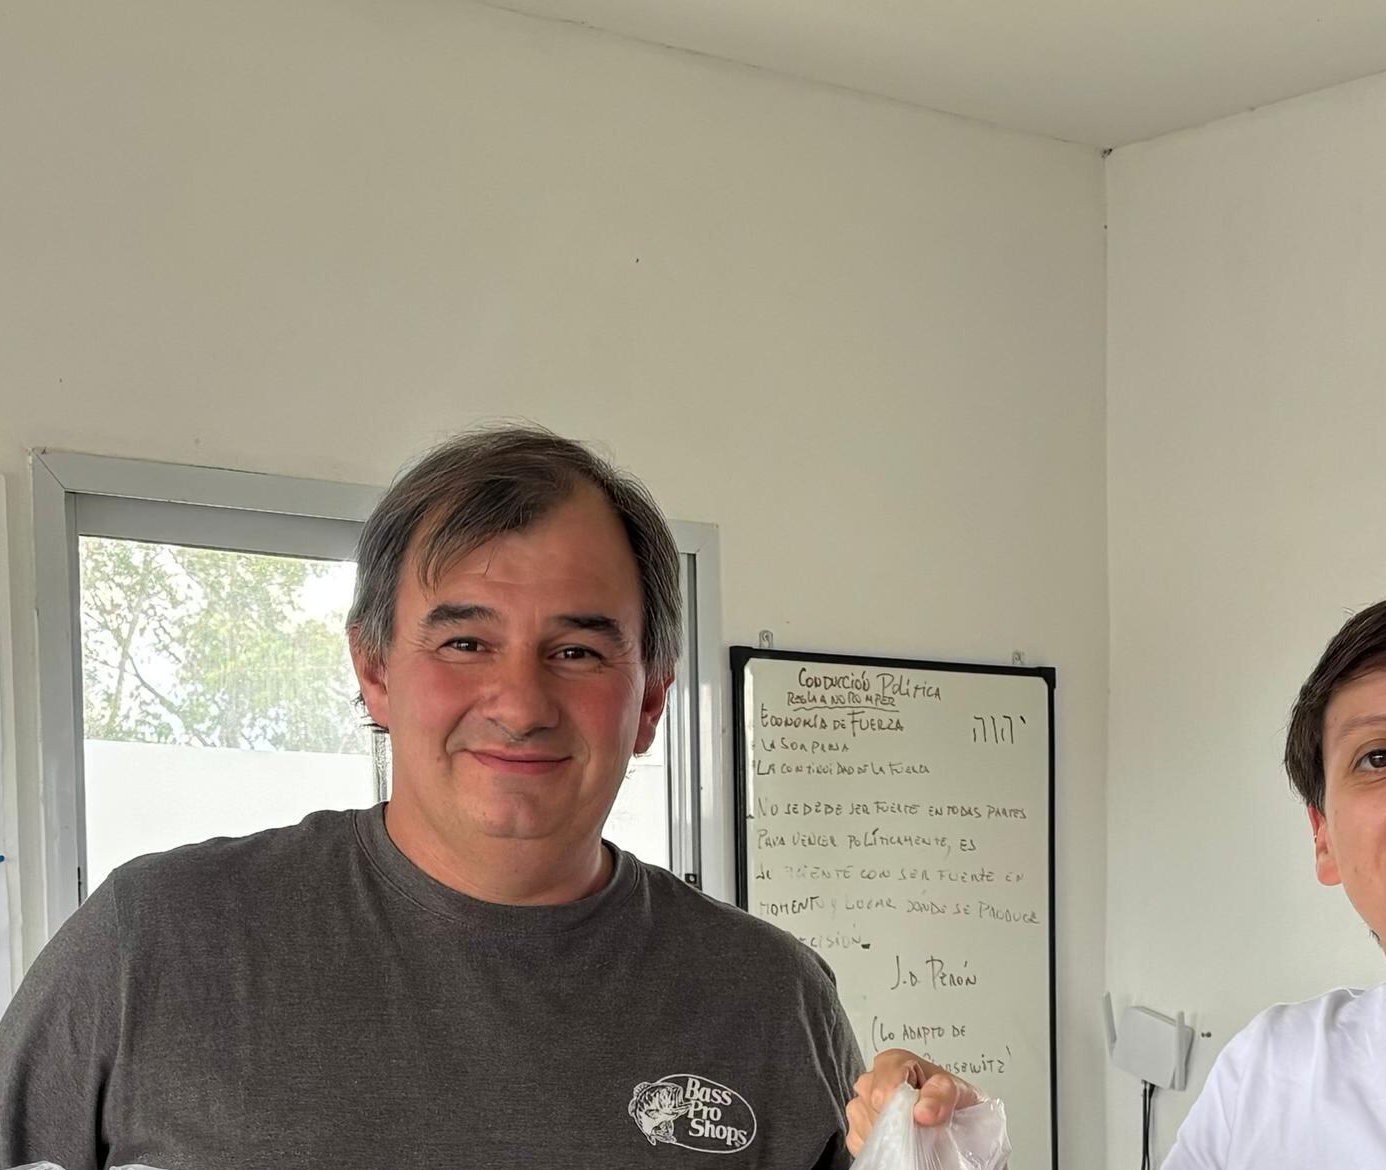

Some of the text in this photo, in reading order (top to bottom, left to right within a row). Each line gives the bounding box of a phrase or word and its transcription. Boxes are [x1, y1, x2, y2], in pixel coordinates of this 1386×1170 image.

[685, 1077, 732, 1106] Bass
[686, 1100, 722, 1121] Pro
[688, 1118, 748, 1147] Shops
